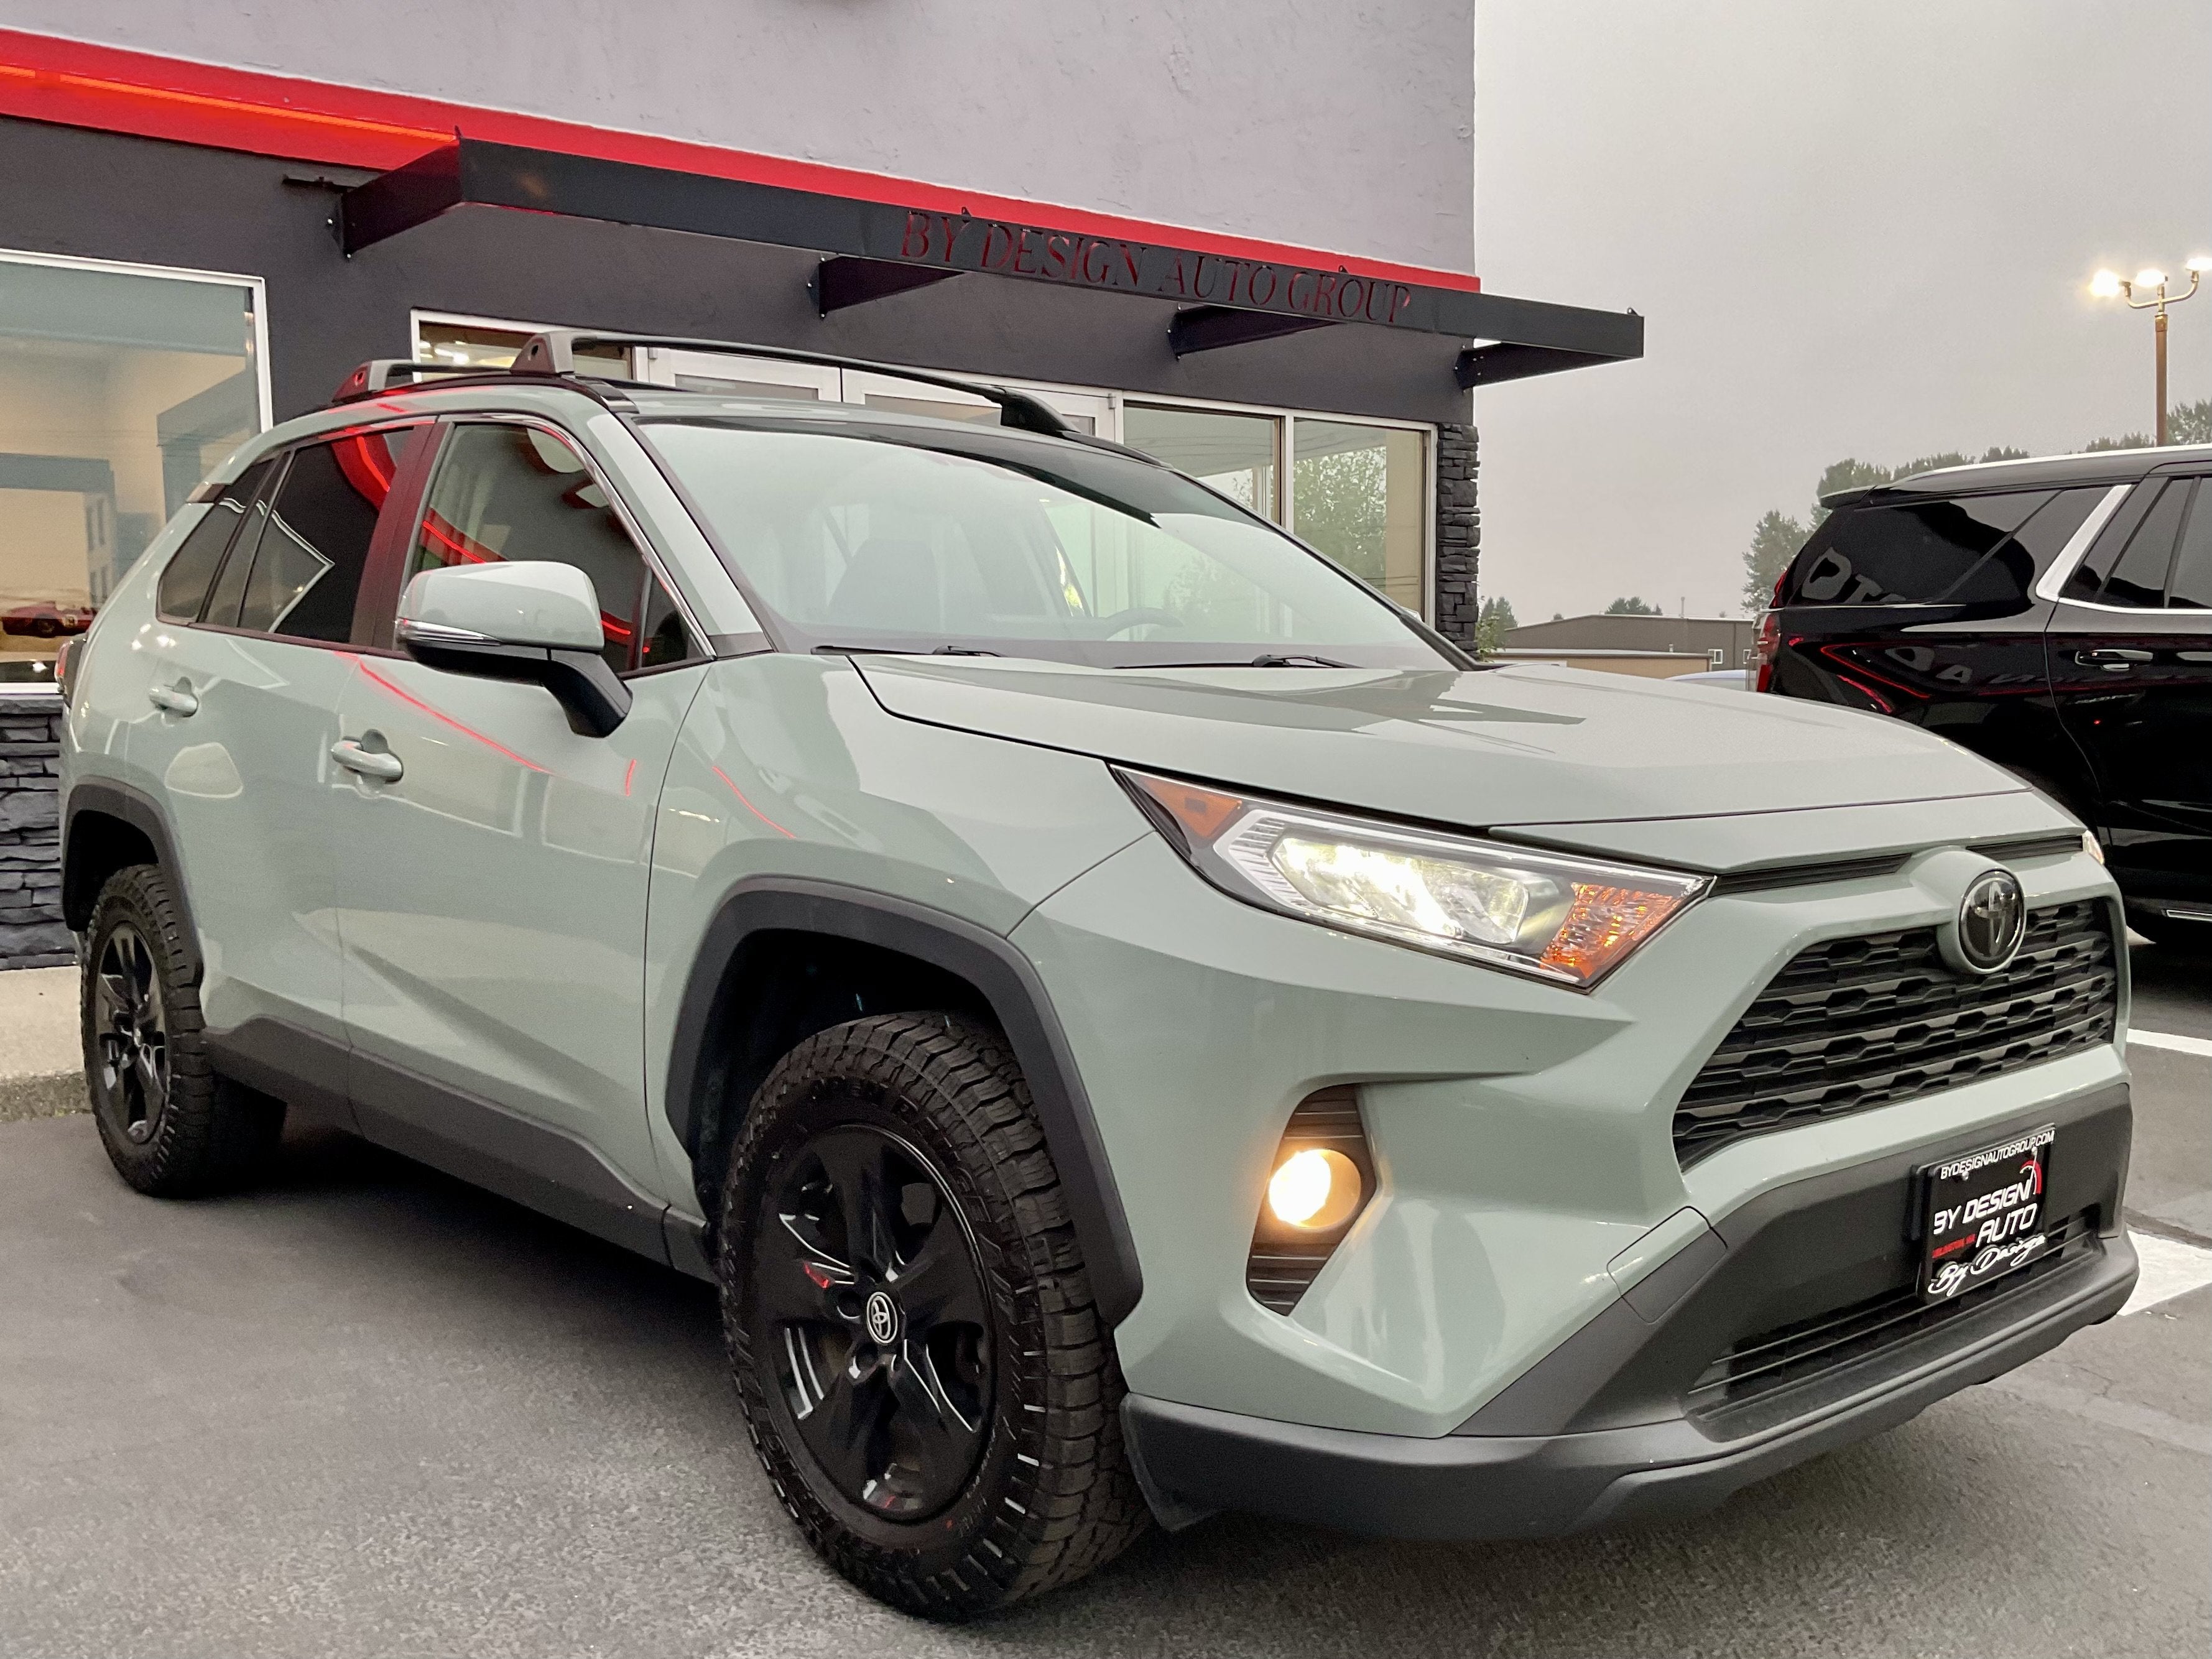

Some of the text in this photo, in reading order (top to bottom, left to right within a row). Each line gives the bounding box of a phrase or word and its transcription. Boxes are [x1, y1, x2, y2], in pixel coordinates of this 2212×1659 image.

[900, 210, 1412, 323] BY DESIGN AUTO GROUP
[1940, 1130, 2055, 1180] BYDESIGNAUTOGROUP.COM
[1933, 1178, 2032, 1235] BY DESIGN
[1975, 1203, 2038, 1248] AUTO
